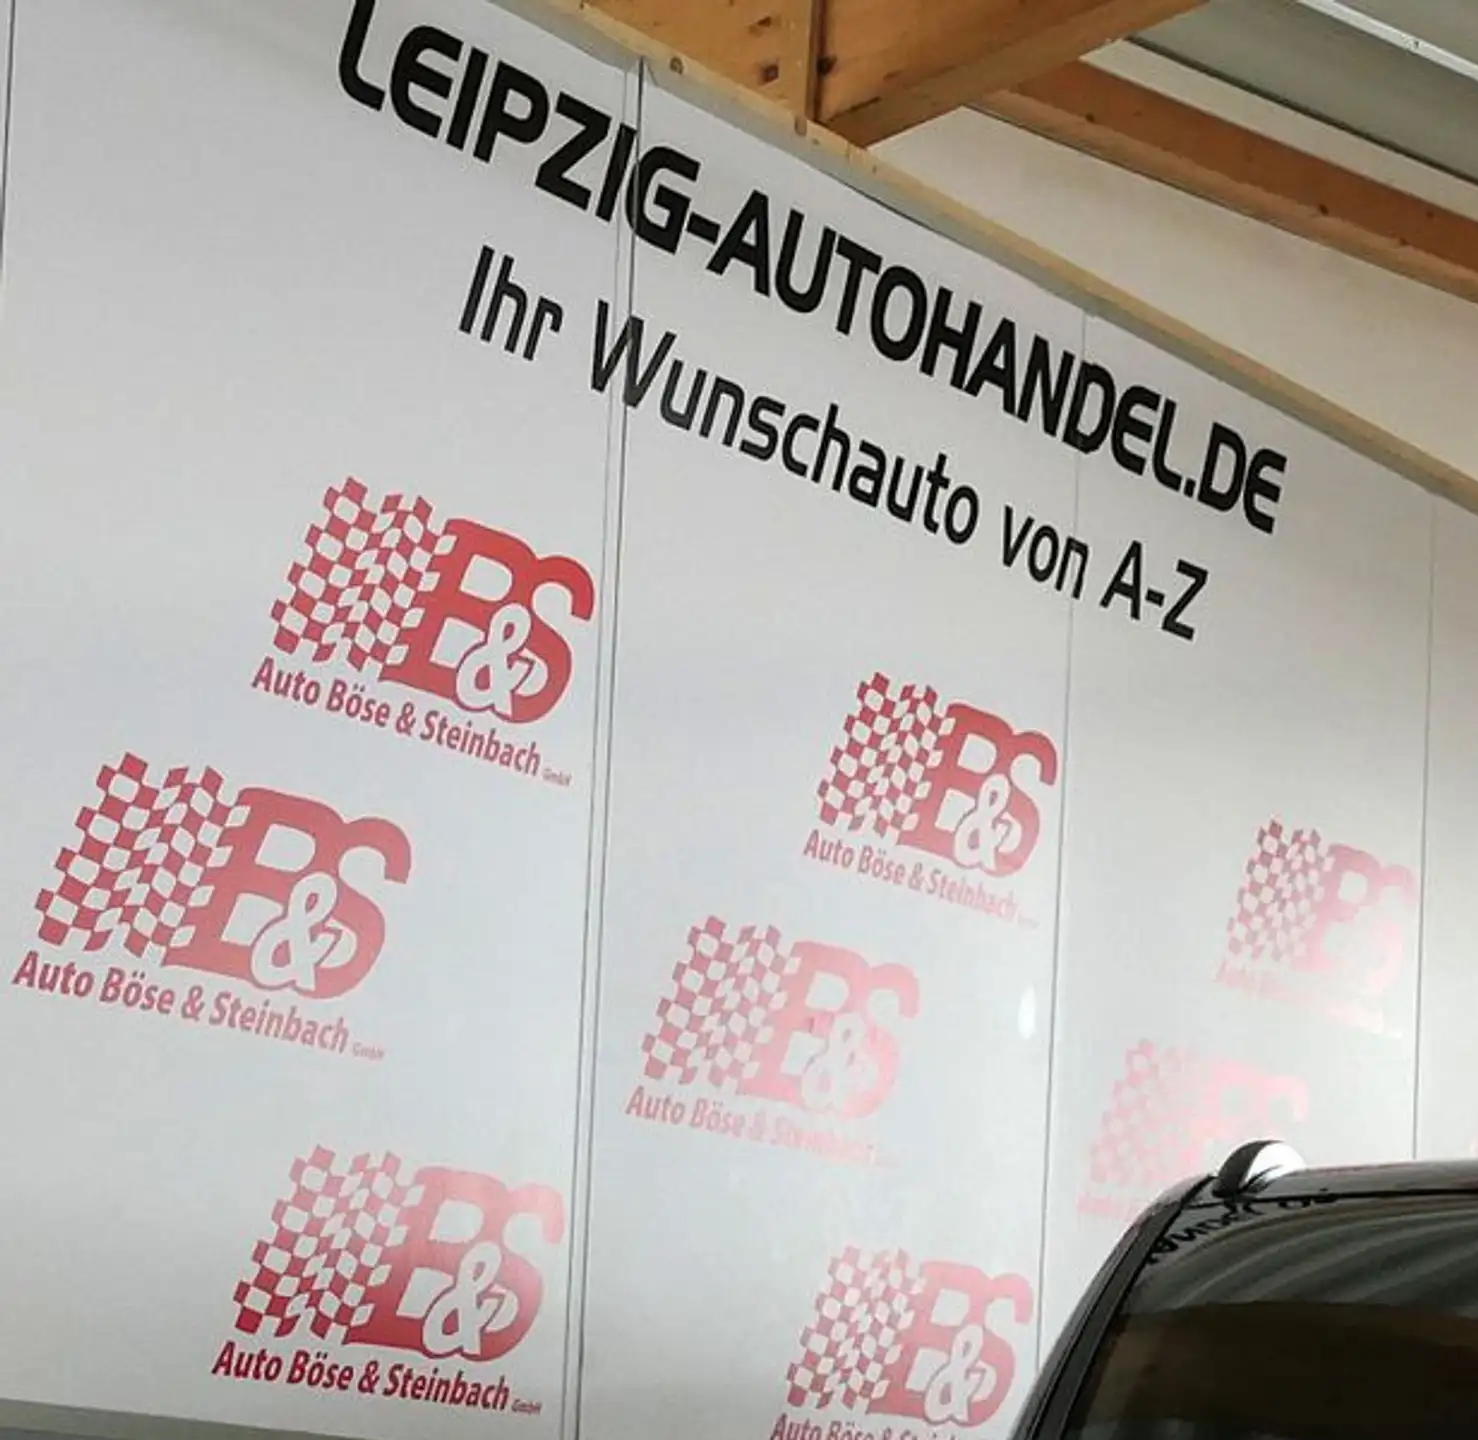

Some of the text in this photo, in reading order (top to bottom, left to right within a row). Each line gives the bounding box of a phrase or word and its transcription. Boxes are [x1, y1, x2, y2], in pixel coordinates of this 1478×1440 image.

[338, 0, 1287, 533] LEIPZIG-AUTOHANDEL.DE
[459, 244, 1208, 641] Ihr Wunschauto von A-Z
[378, 518, 595, 724] B&S
[251, 655, 321, 706] Auto
[326, 680, 391, 728] Böse
[396, 702, 415, 736] &
[420, 709, 541, 777] Steinbach
[896, 703, 1057, 877] B&S
[162, 788, 411, 998] B&S
[803, 829, 854, 868] Auto
[858, 845, 906, 885] Böse
[908, 862, 923, 892] &
[926, 869, 1017, 922] Steinbach
[12, 951, 94, 998] Auto
[100, 967, 175, 1015] Böse
[181, 985, 205, 1022] &
[209, 992, 349, 1054] Steinbach
[625, 1085, 685, 1126] Auto
[689, 1097, 745, 1138] Böse
[342, 1166, 565, 1362] B&S
[866, 1260, 1033, 1427] B&S
[212, 1340, 282, 1382] Auto
[286, 1350, 354, 1390] Böse
[357, 1360, 380, 1394] &
[383, 1363, 509, 1411] Steinbach
